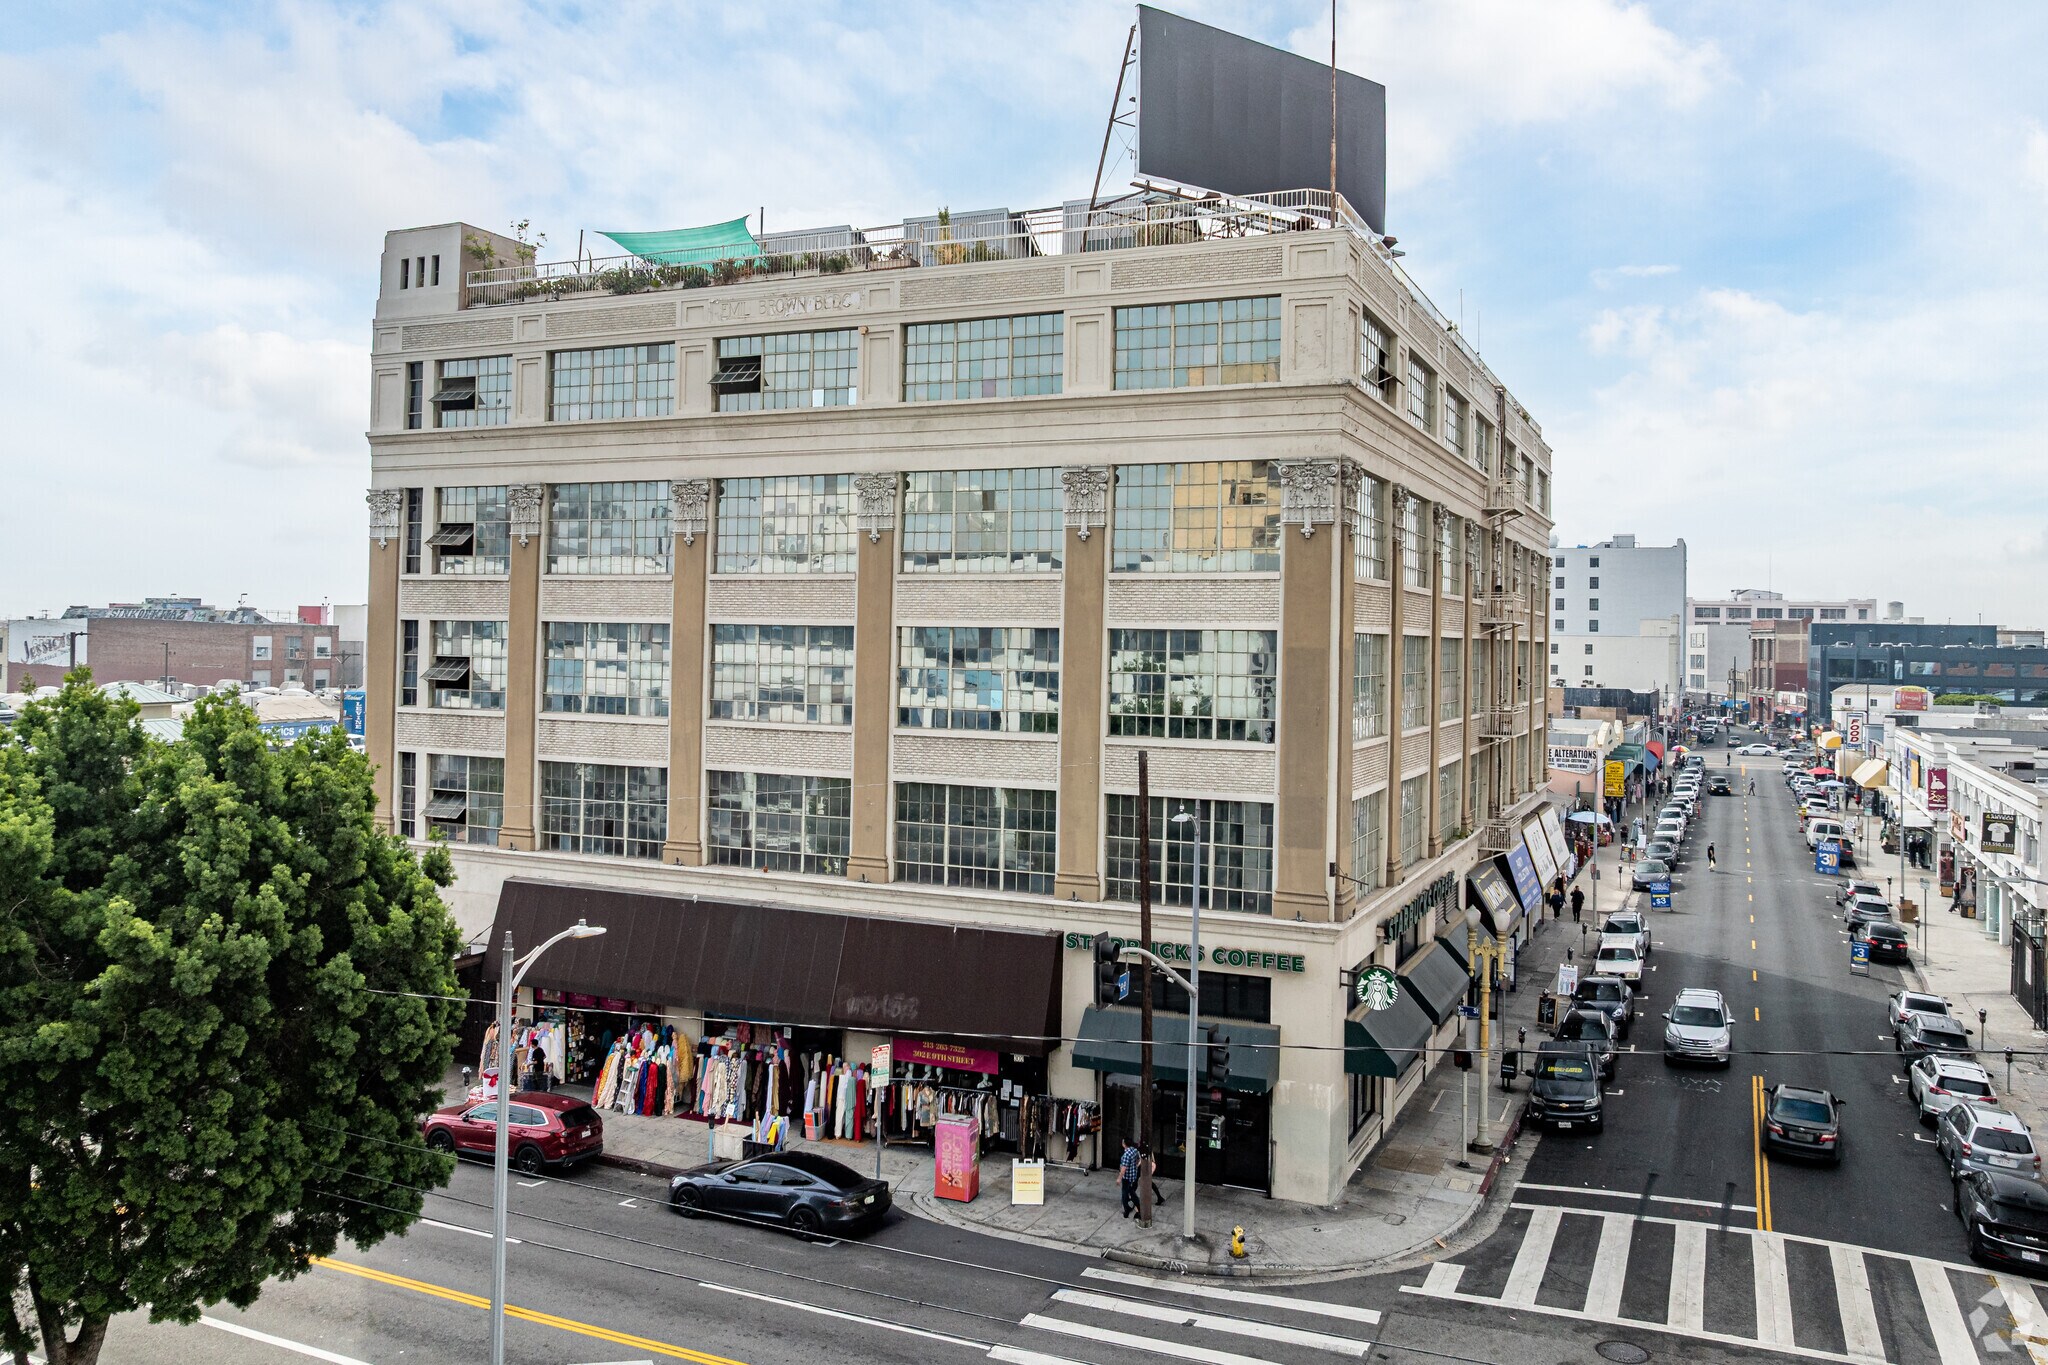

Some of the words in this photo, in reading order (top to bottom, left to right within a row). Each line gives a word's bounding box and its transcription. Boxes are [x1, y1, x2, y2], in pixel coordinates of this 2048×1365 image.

[759, 296, 808, 315] BROWN
[262, 725, 295, 736] faics
[1850, 719, 1860, 743] FOOD
[1555, 749, 1597, 759] ALTERATIONS
[1656, 897, 1667, 905] $3
[1212, 947, 1305, 973] COFFEE
[947, 1054, 976, 1065] STREET
[952, 1134, 963, 1188] DISTRICT
